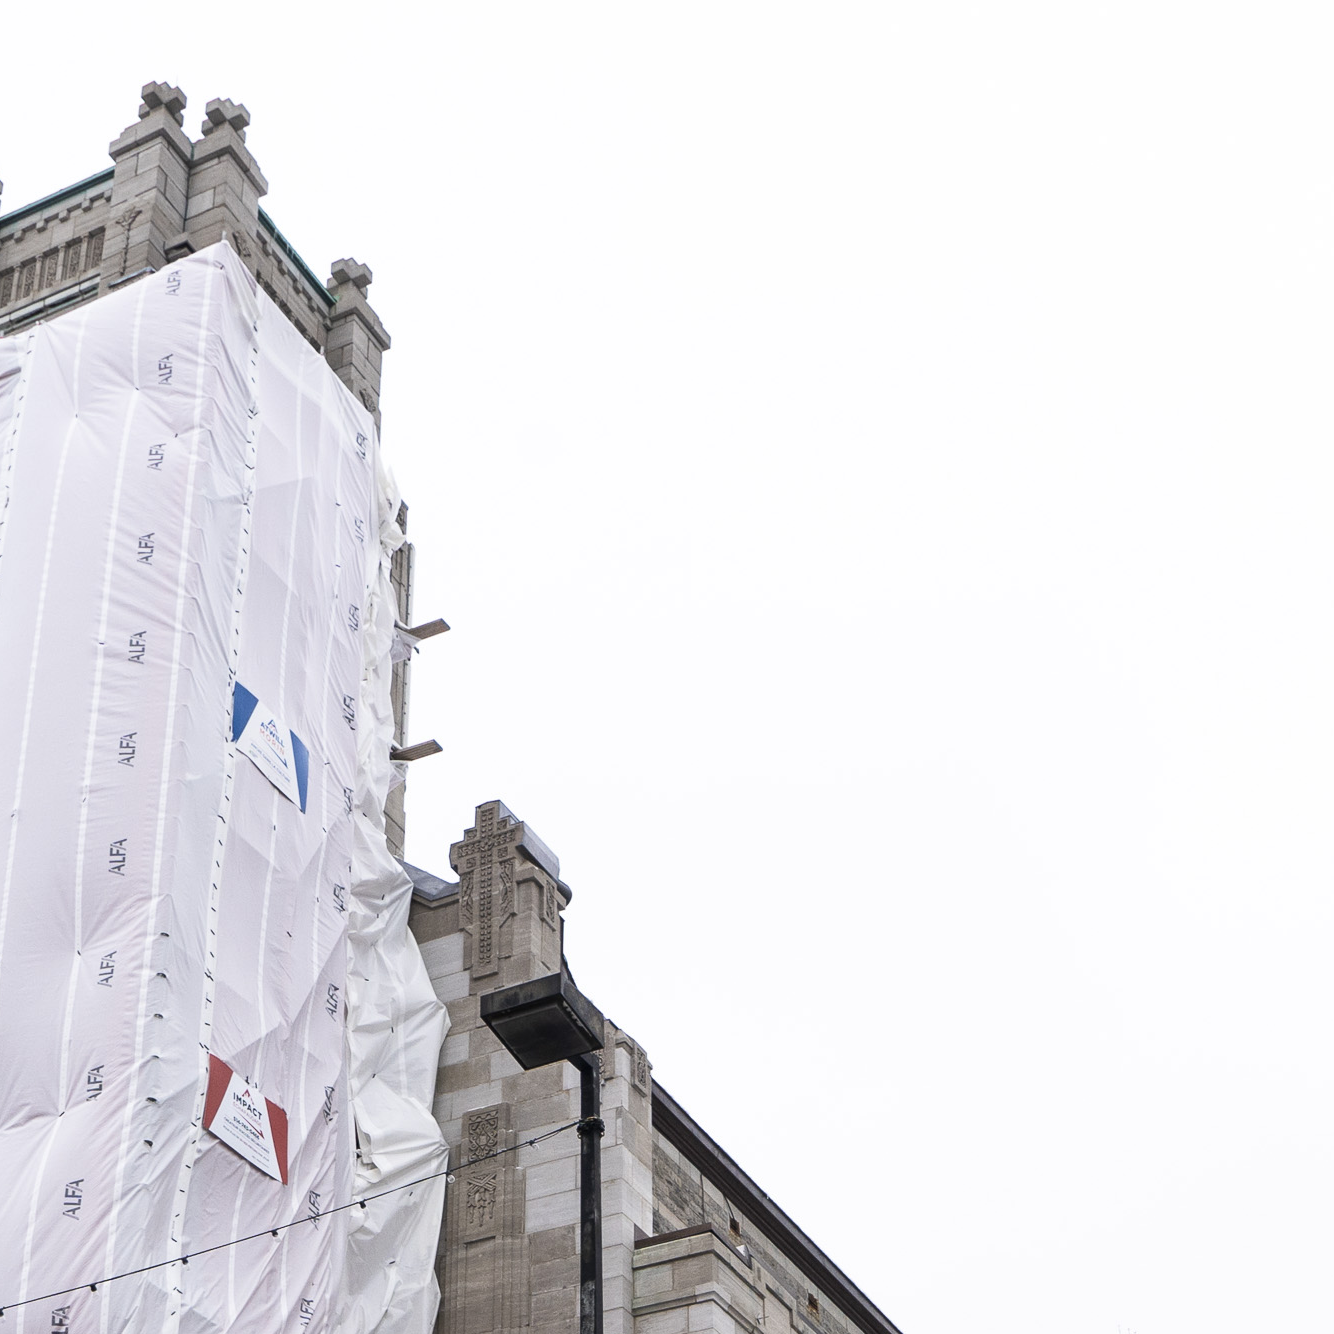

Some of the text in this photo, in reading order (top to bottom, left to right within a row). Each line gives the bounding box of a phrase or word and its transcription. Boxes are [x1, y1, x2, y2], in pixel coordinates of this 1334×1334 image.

[165, 267, 182, 297] ALFA
[158, 353, 174, 385] ALFA
[147, 442, 167, 472] ALFA
[136, 531, 155, 566] ALFA
[127, 629, 147, 665] ALFA
[117, 731, 138, 768] ALFA
[108, 837, 128, 876] ALFA
[96, 949, 117, 988] ALFA
[324, 982, 339, 1022] ALFA
[87, 1064, 105, 1102] ALFA
[233, 1092, 262, 1120] IMPACT
[62, 1178, 84, 1221] ALFA
